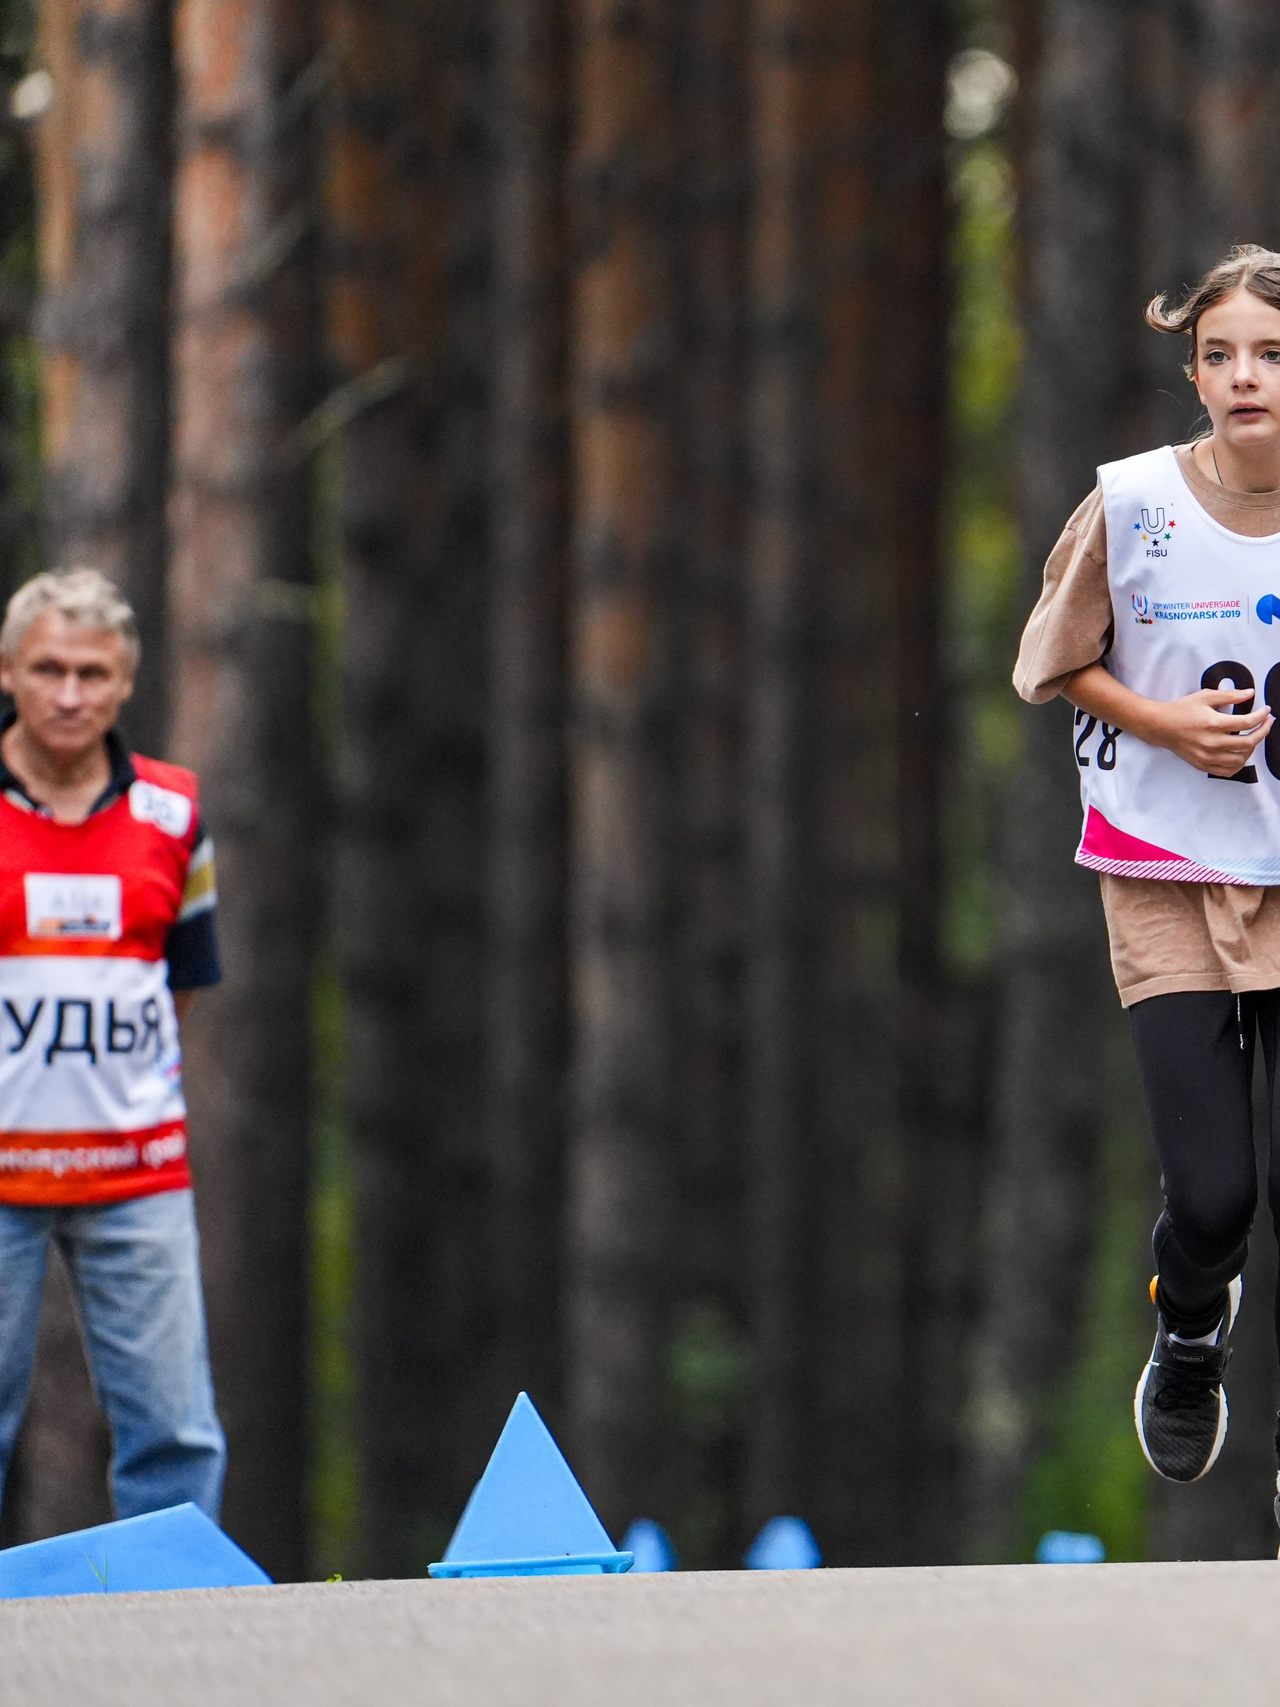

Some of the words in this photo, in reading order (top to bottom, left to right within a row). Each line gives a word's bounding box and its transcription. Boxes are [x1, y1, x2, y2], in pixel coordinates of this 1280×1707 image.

[1146, 549, 1168, 558] FISU
[1162, 602, 1190, 610] WINTER
[1191, 600, 1241, 609] UNIVERSIADE
[1154, 610, 1218, 621] KRASNOYARSK
[1220, 609, 1241, 619] 2019
[1075, 708, 1123, 770] 28
[3, 997, 163, 1065] УДЬЯ
